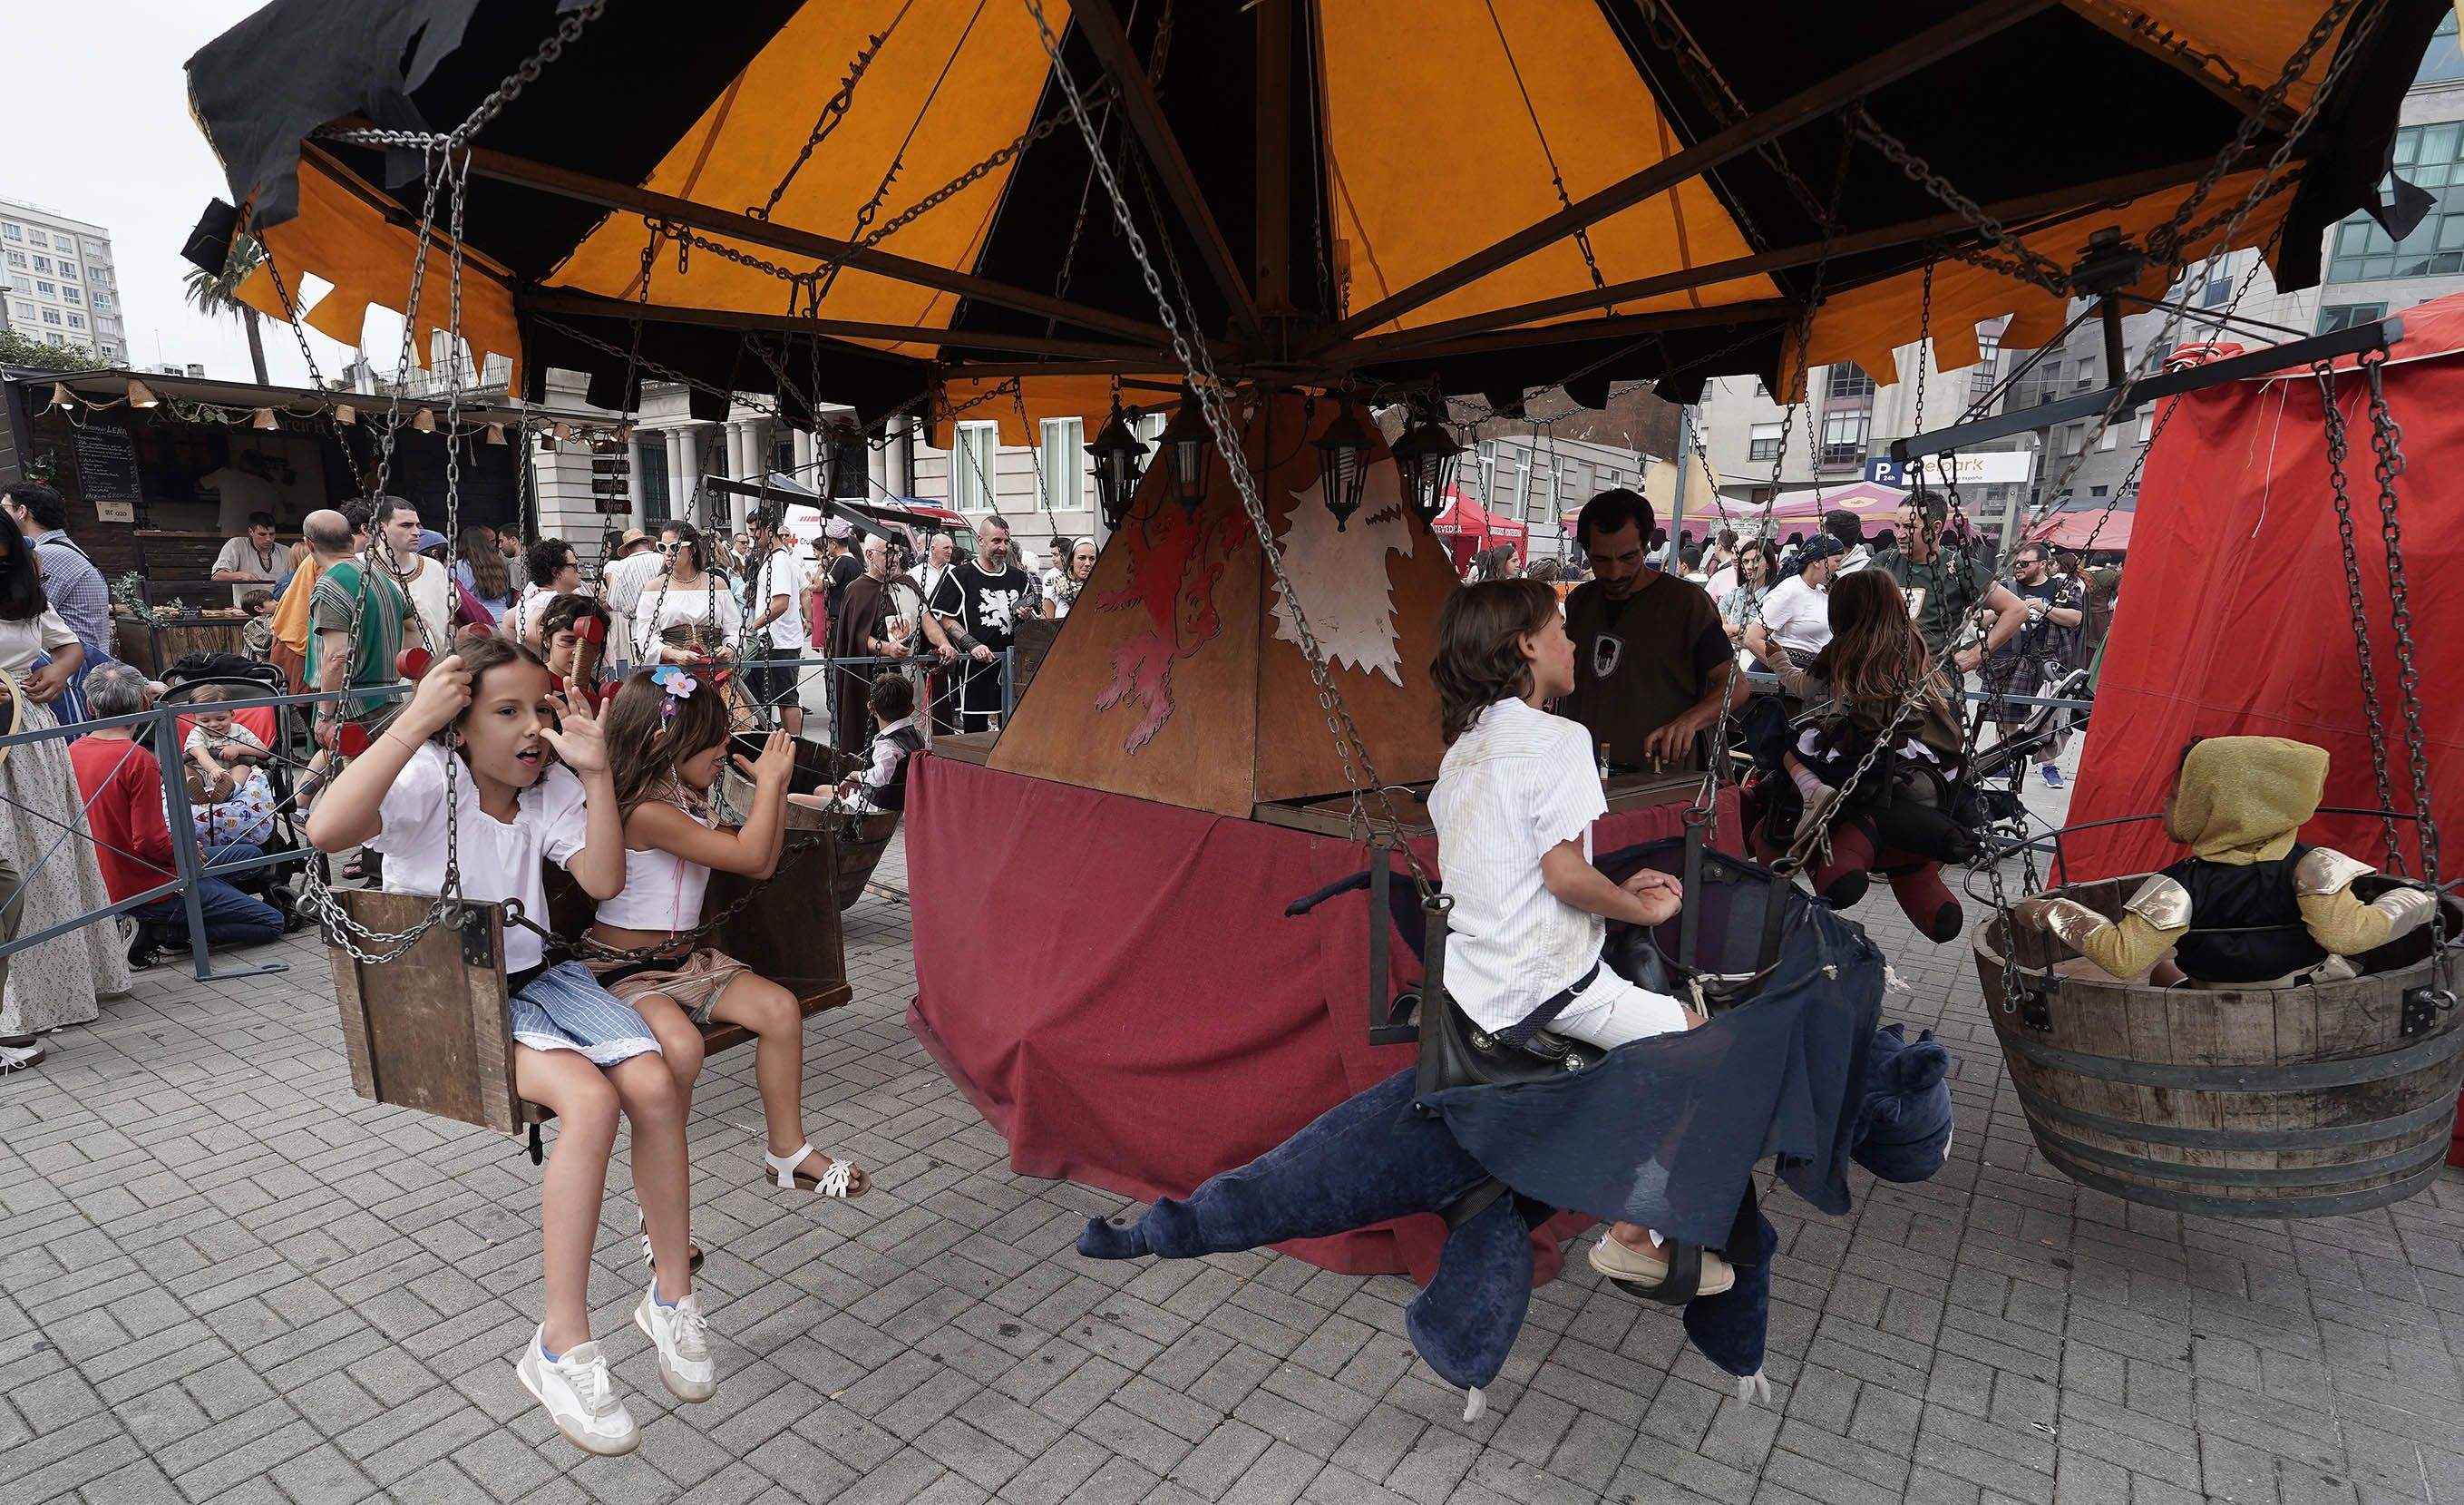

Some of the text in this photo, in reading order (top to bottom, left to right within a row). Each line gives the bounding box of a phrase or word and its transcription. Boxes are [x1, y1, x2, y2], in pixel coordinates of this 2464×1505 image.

[1875, 462, 1892, 481] P
[1925, 459, 1984, 474] epark
[1435, 524, 1462, 534] TEVEDA
